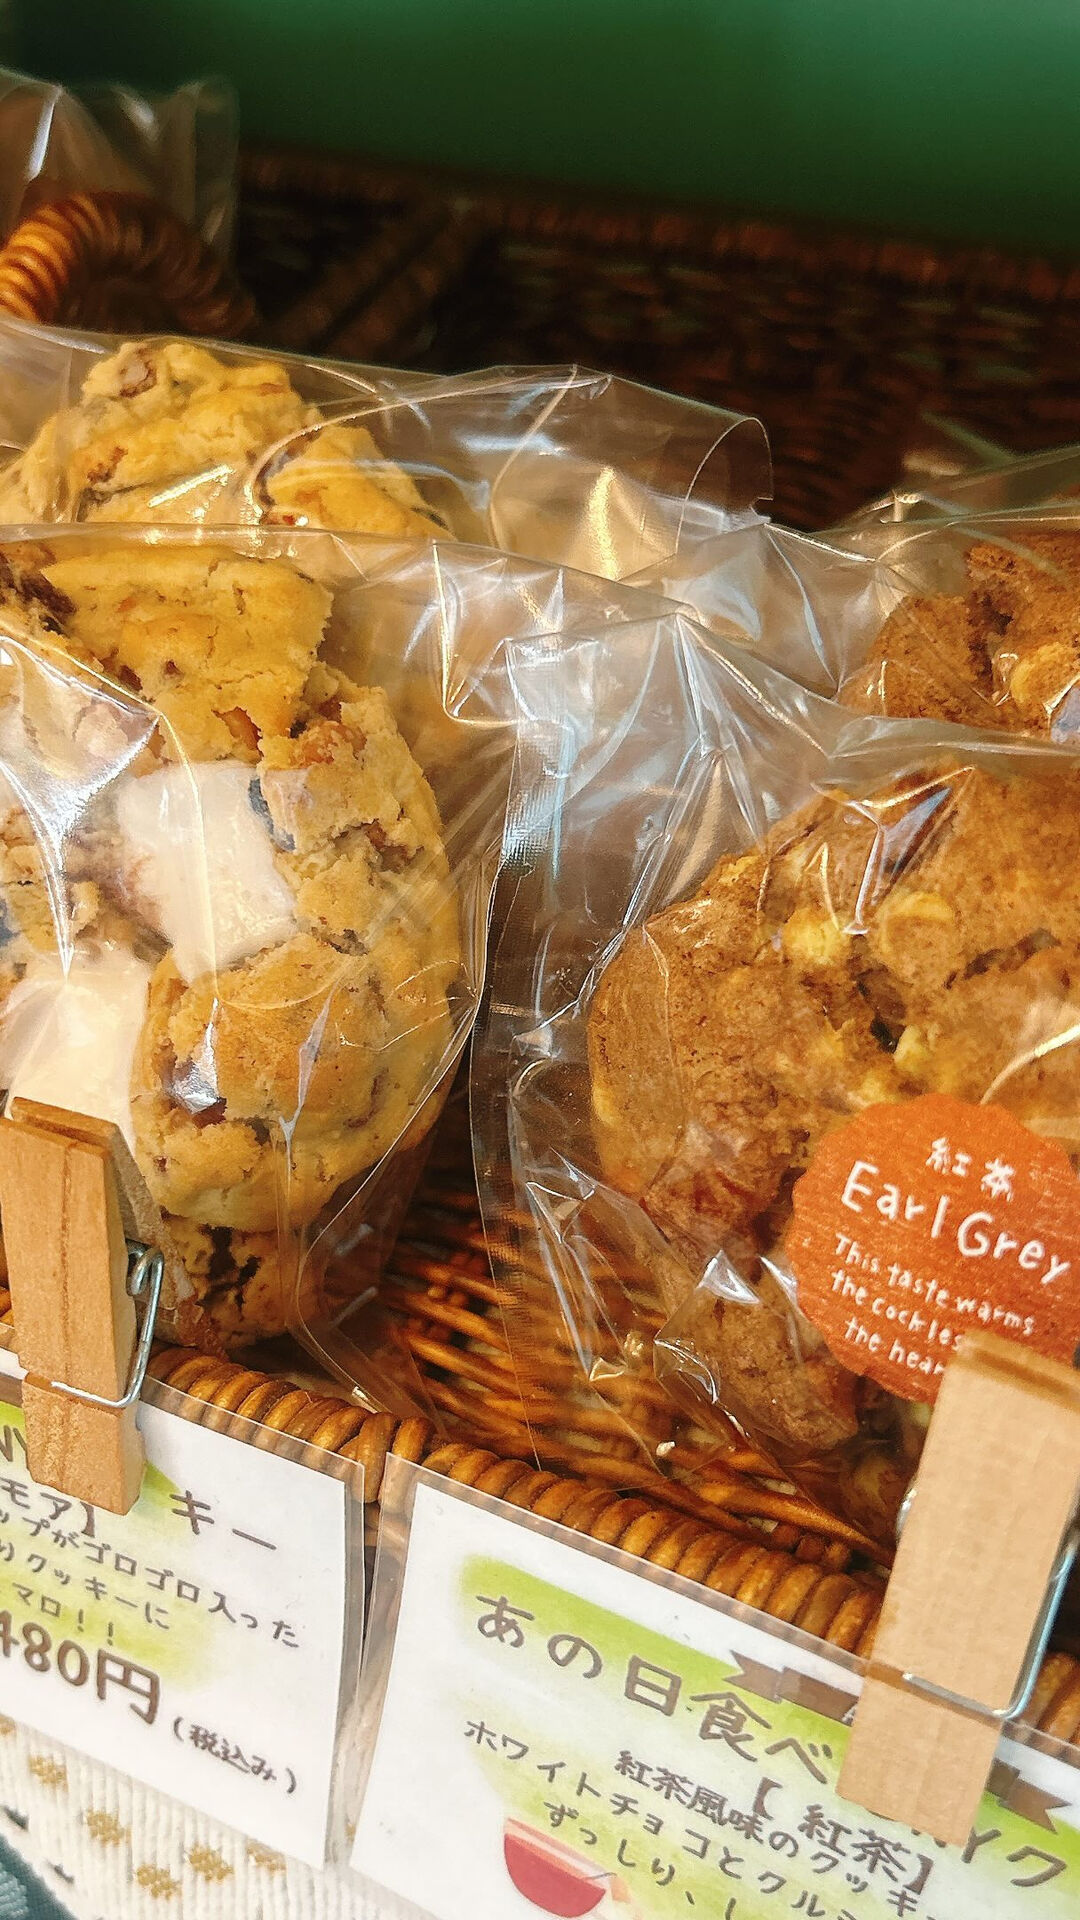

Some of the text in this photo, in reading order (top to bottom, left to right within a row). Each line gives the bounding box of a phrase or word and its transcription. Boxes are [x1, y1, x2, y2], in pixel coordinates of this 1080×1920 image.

[926, 1137, 1016, 1202] 紅茶
[842, 1160, 1071, 1285] Earl Grey
[831, 1269, 963, 1352] the cockles
[835, 1232, 1035, 1336] This taste warms
[845, 1316, 881, 1352] the
[170, 1489, 277, 1552] キー
[475, 1595, 833, 1785] あの日食べ
[752, 1776, 934, 1896] 【紅茶】
